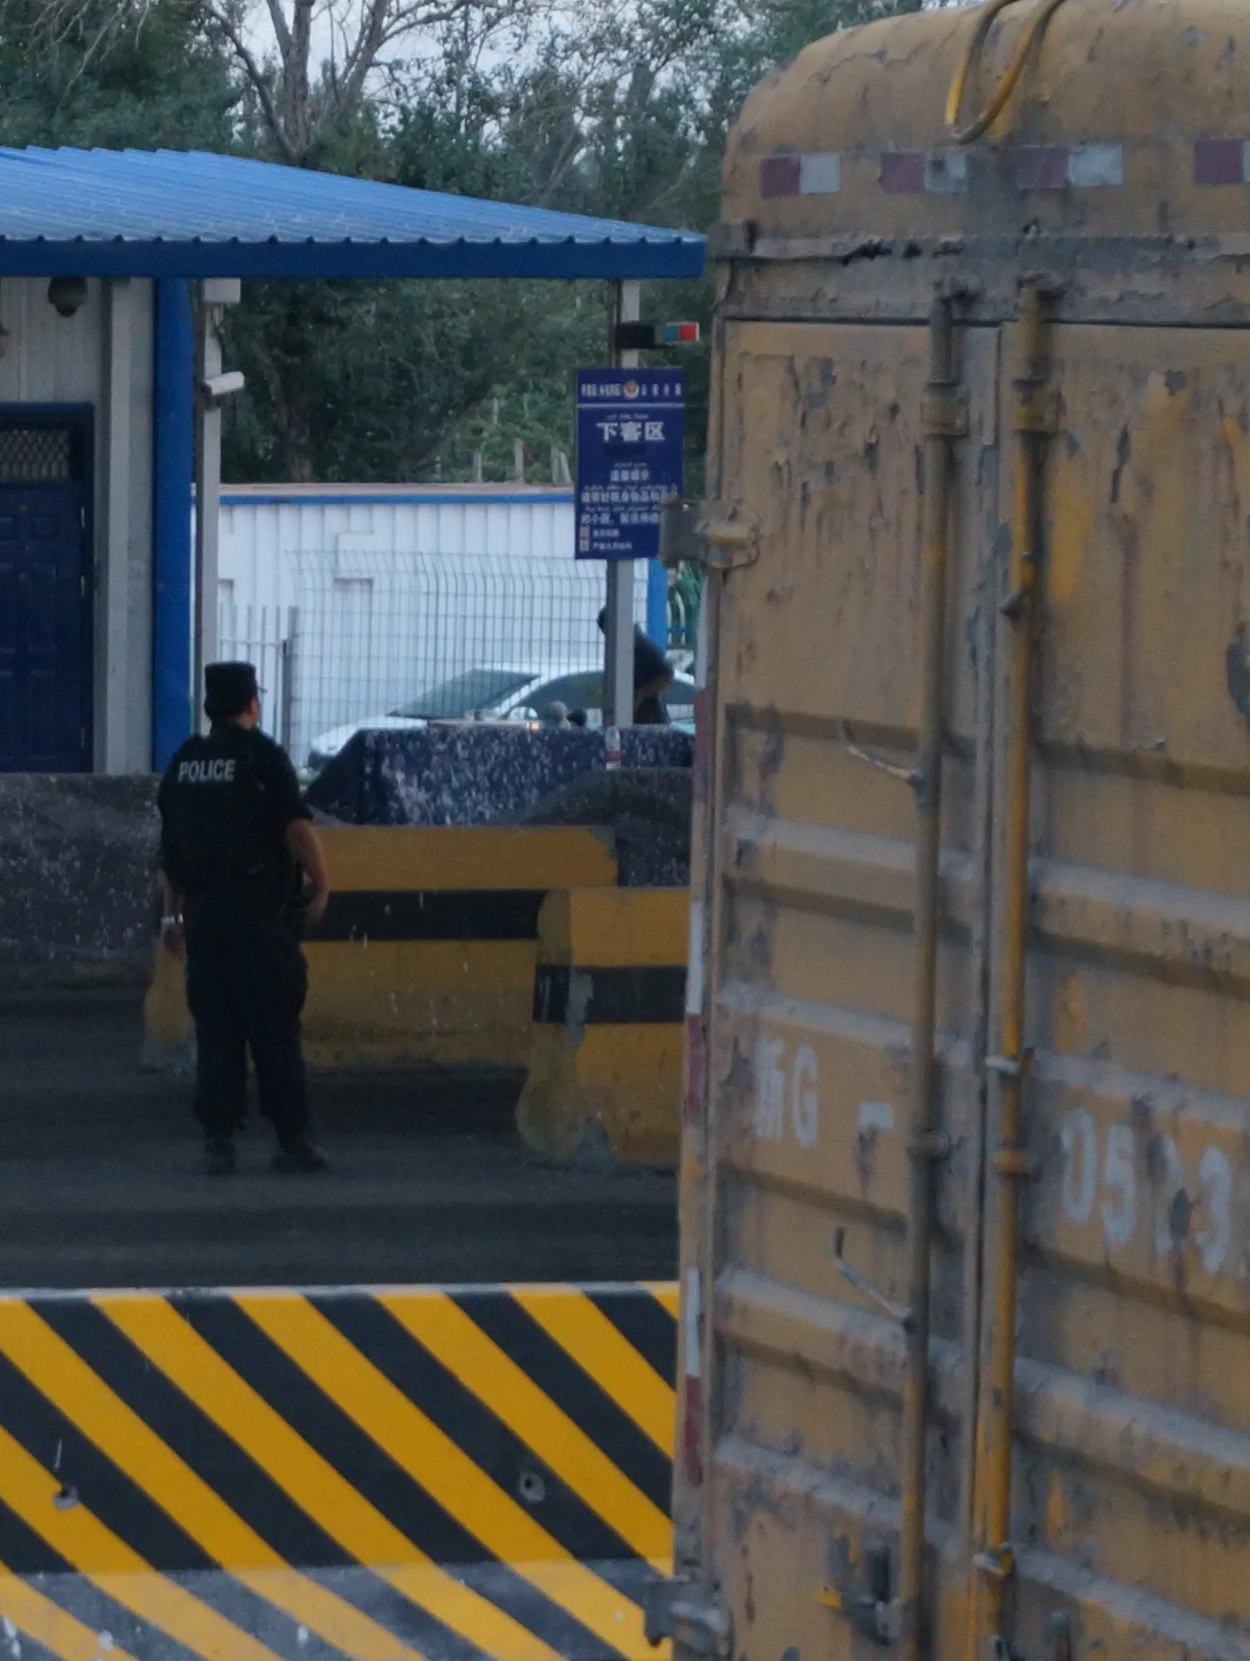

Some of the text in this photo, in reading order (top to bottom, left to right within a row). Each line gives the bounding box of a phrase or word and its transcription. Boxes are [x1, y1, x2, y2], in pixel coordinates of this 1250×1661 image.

[595, 420, 666, 443] 下客区
[178, 757, 237, 783] POLICE
